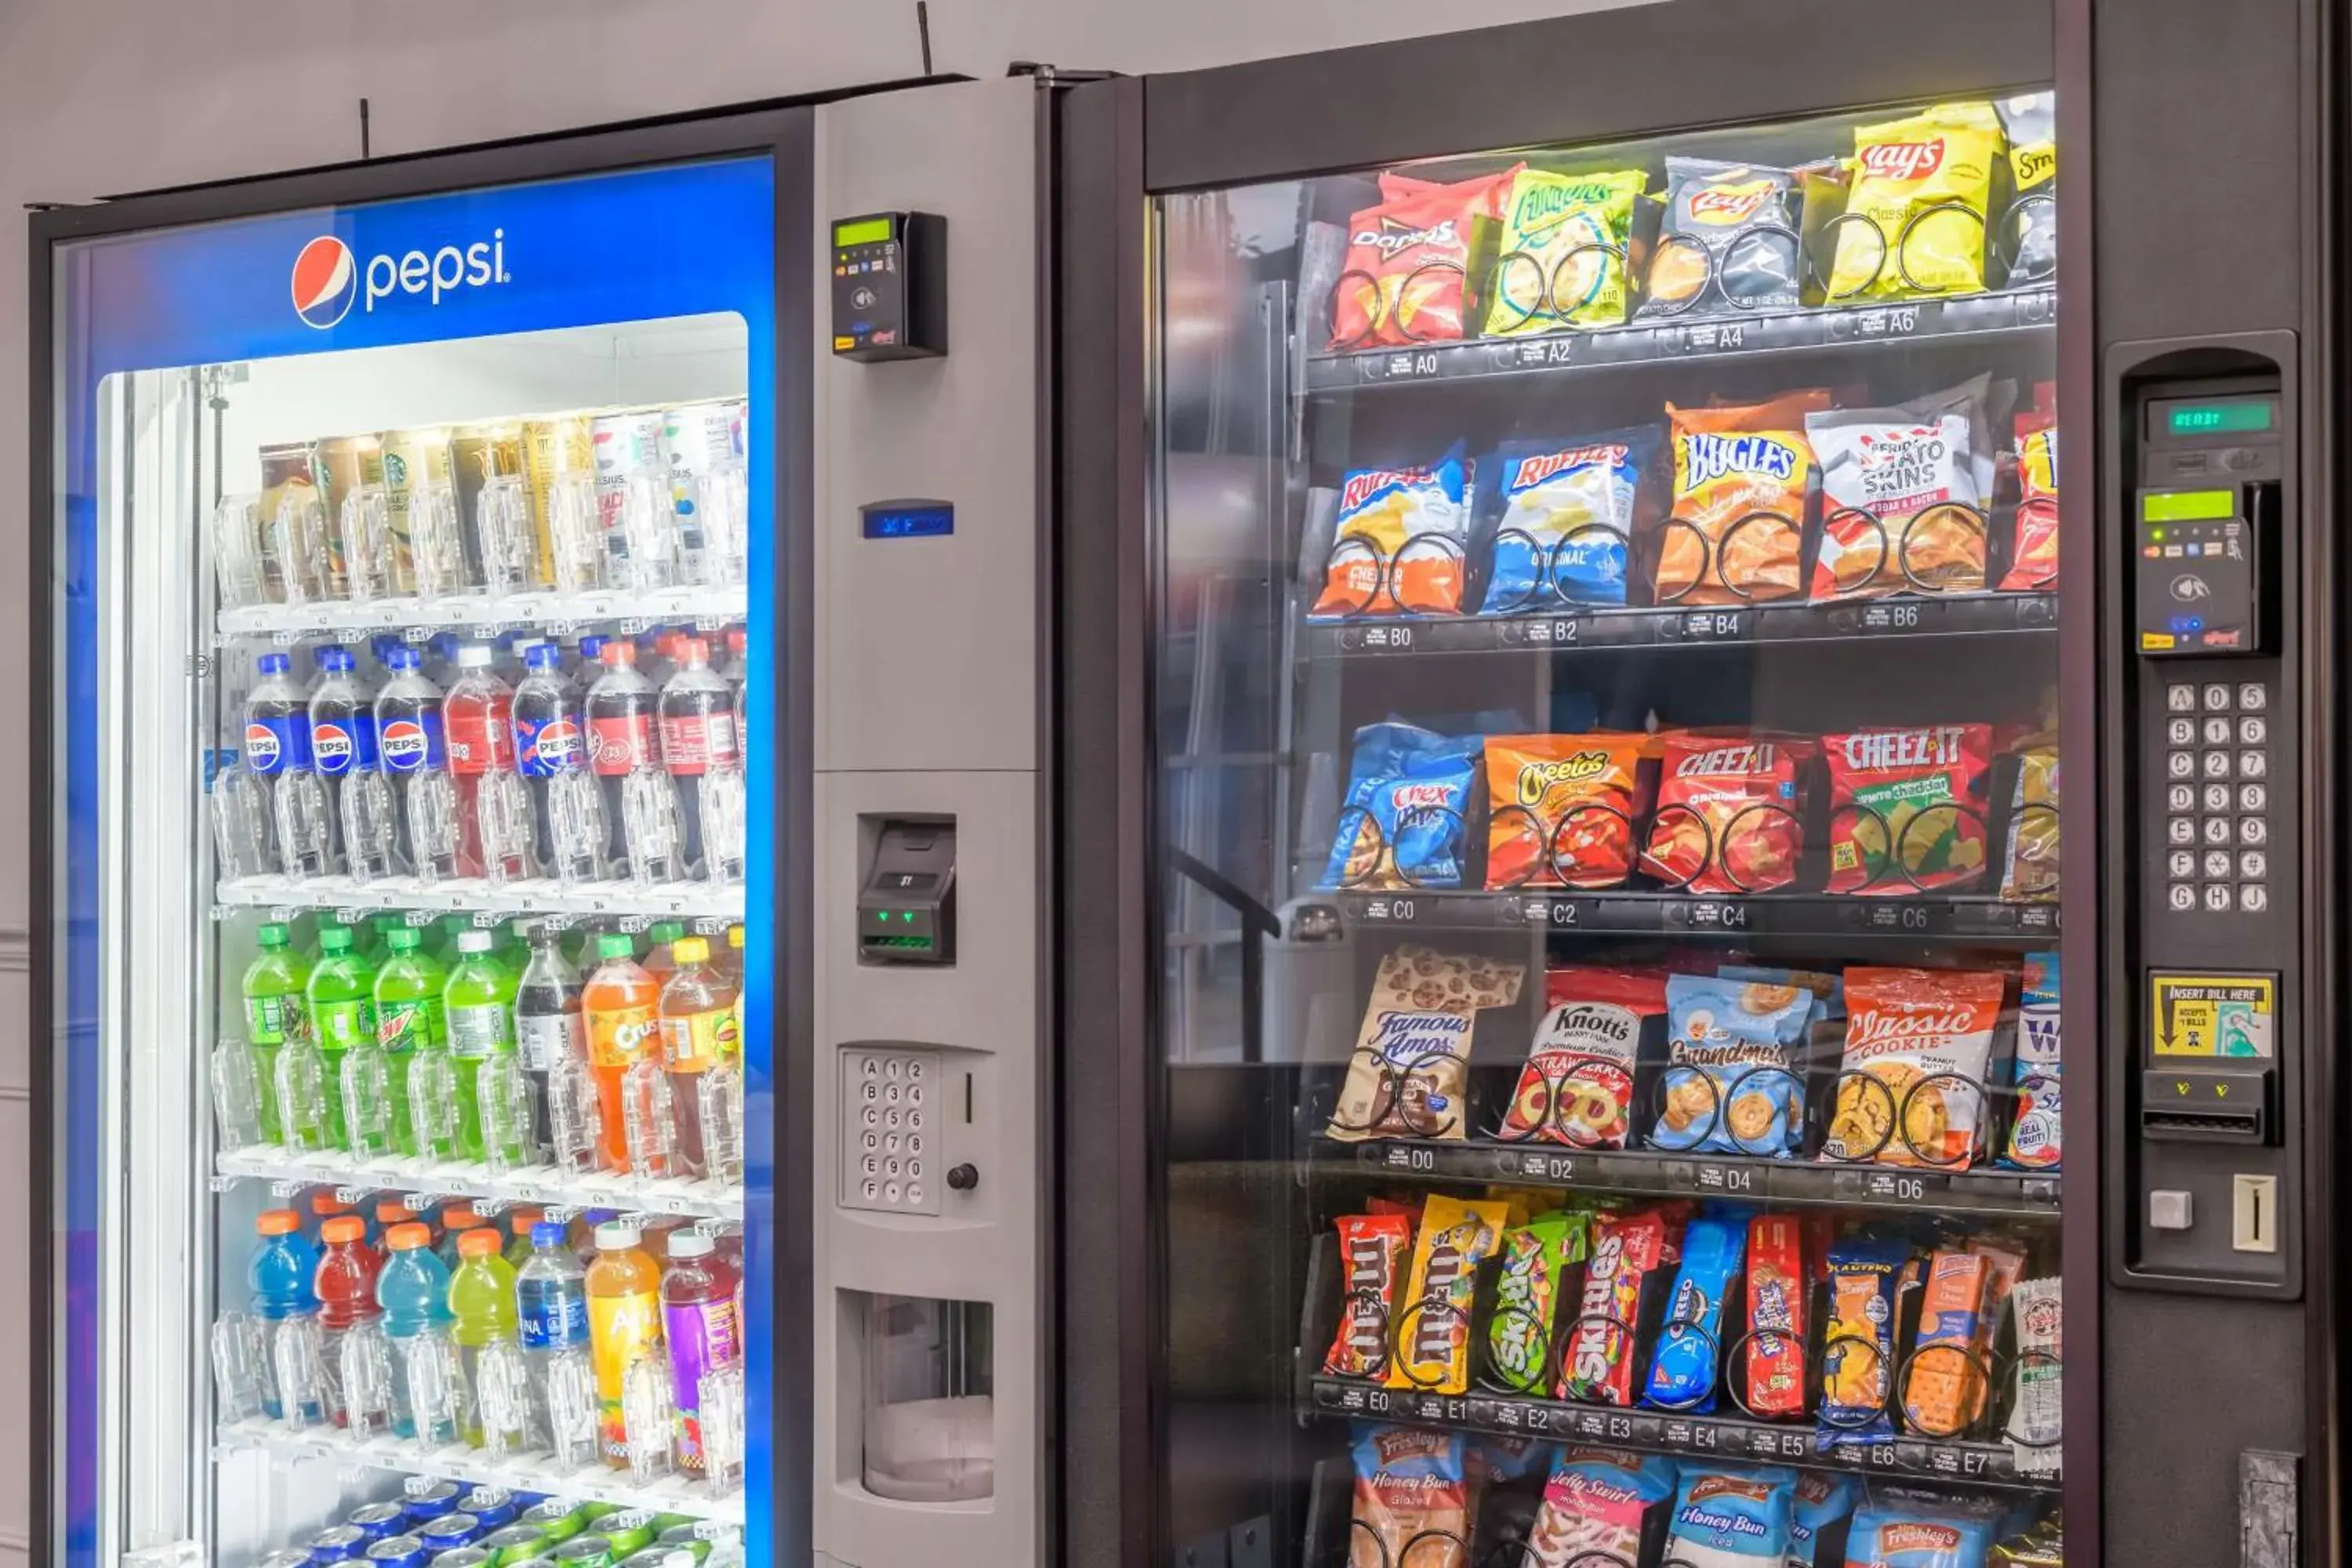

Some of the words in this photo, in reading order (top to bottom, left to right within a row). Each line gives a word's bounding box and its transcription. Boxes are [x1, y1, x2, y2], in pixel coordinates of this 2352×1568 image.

[1862, 139, 1944, 180] Lay's
[366, 227, 503, 313] pepsi
[1890, 311, 1915, 331] A6
[1719, 328, 1744, 348] A4
[1548, 341, 1570, 362] A2
[1416, 354, 1437, 374] A0
[1684, 434, 1795, 491] BUGLES
[1864, 463, 1936, 494] SKINS
[318, 616, 328, 625] A2
[1715, 615, 1739, 634] B4
[1894, 605, 1918, 626] B6
[1391, 627, 1411, 646] B0
[1555, 620, 1577, 641] B2
[2175, 690, 2187, 706] A
[2247, 688, 2258, 706] 5
[2176, 723, 2187, 740] B
[2212, 723, 2220, 739] 1
[2246, 722, 2258, 739] 6
[2176, 756, 2187, 773] C
[2211, 756, 2221, 772] 2
[2248, 756, 2258, 772] 7
[1519, 752, 1609, 808] Cheetos
[1392, 784, 1460, 810] Chex
[2176, 789, 2187, 805] D
[2212, 788, 2221, 805] 3
[2247, 788, 2258, 806] 8
[2176, 822, 2187, 839] E
[2211, 822, 2222, 839] 4
[2247, 822, 2258, 839] 9
[2176, 855, 2187, 871] F
[2176, 888, 2187, 906] G
[2212, 889, 2223, 906] H
[2249, 889, 2258, 906] J
[1393, 900, 1414, 920] C0
[1553, 903, 1576, 924] C2
[1722, 905, 1745, 926] C4
[1902, 906, 1928, 928] C6
[2169, 986, 2205, 1000] INSERT
[2207, 989, 2227, 1000] BILL
[2230, 989, 2256, 1000] HERE
[2180, 1008, 2207, 1017] ACCEPTS
[1369, 1011, 1471, 1045] Famous
[1552, 1007, 1630, 1041] Knott's
[1844, 1008, 1974, 1054] Classic
[1860, 1036, 1941, 1058] COOKIE
[868, 1061, 877, 1074] A
[891, 1063, 896, 1076] 1
[913, 1064, 920, 1077] 2
[868, 1086, 876, 1098] B
[891, 1087, 898, 1100] 3
[913, 1089, 920, 1102] 4
[868, 1110, 876, 1123] C
[891, 1112, 898, 1124] 5
[913, 1113, 920, 1127] 6
[868, 1135, 876, 1148] D
[891, 1136, 898, 1149] 7
[913, 1138, 920, 1151] 8
[868, 1159, 876, 1172] E
[891, 1161, 898, 1174] 9
[913, 1163, 920, 1175] 0
[1550, 1159, 1573, 1179] D2
[868, 1183, 876, 1196] F
[1728, 1170, 1751, 1190] D4
[1897, 1178, 1924, 1200] D6
[1669, 1279, 1693, 1339] OREO
[1369, 1392, 1388, 1411] E0
[1448, 1399, 1466, 1420] E1
[1528, 1409, 1548, 1430] E2
[1610, 1417, 1631, 1439] E3
[1695, 1427, 1716, 1448] E4
[1782, 1436, 1803, 1456] E5
[1872, 1445, 1894, 1466] E6
[1964, 1454, 1989, 1474] E7
[1372, 1471, 1420, 1490] Honey
[1423, 1473, 1450, 1490] Bun
[1551, 1470, 1586, 1494] Jelly
[1586, 1479, 1637, 1504] Swirl
[1681, 1507, 1733, 1533] Honey
[1733, 1516, 1765, 1537] Bun
[1887, 1528, 1958, 1548] Freshley's
